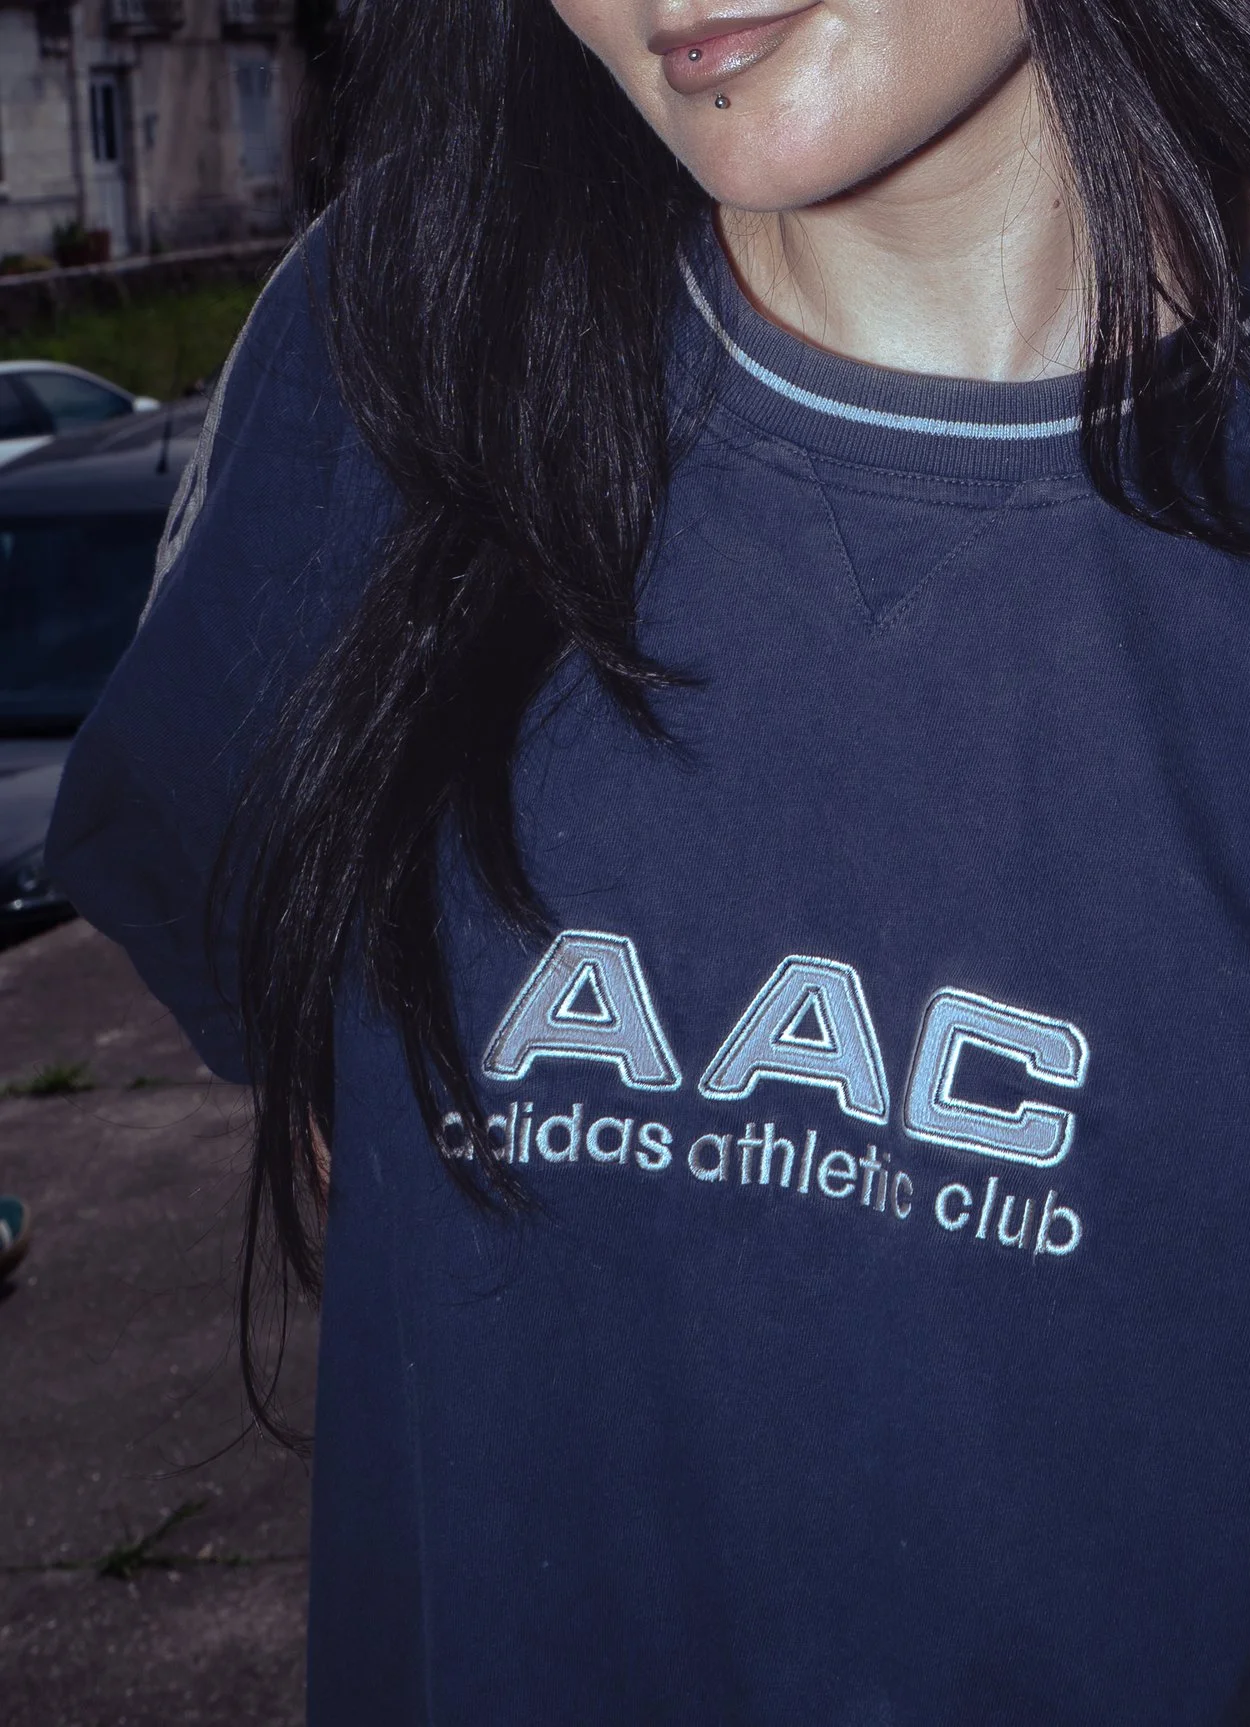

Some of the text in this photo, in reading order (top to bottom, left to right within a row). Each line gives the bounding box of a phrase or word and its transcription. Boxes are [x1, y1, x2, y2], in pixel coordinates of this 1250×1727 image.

[483, 930, 1090, 1167] AAC
[437, 1101, 1083, 1257] adidas athletic club
